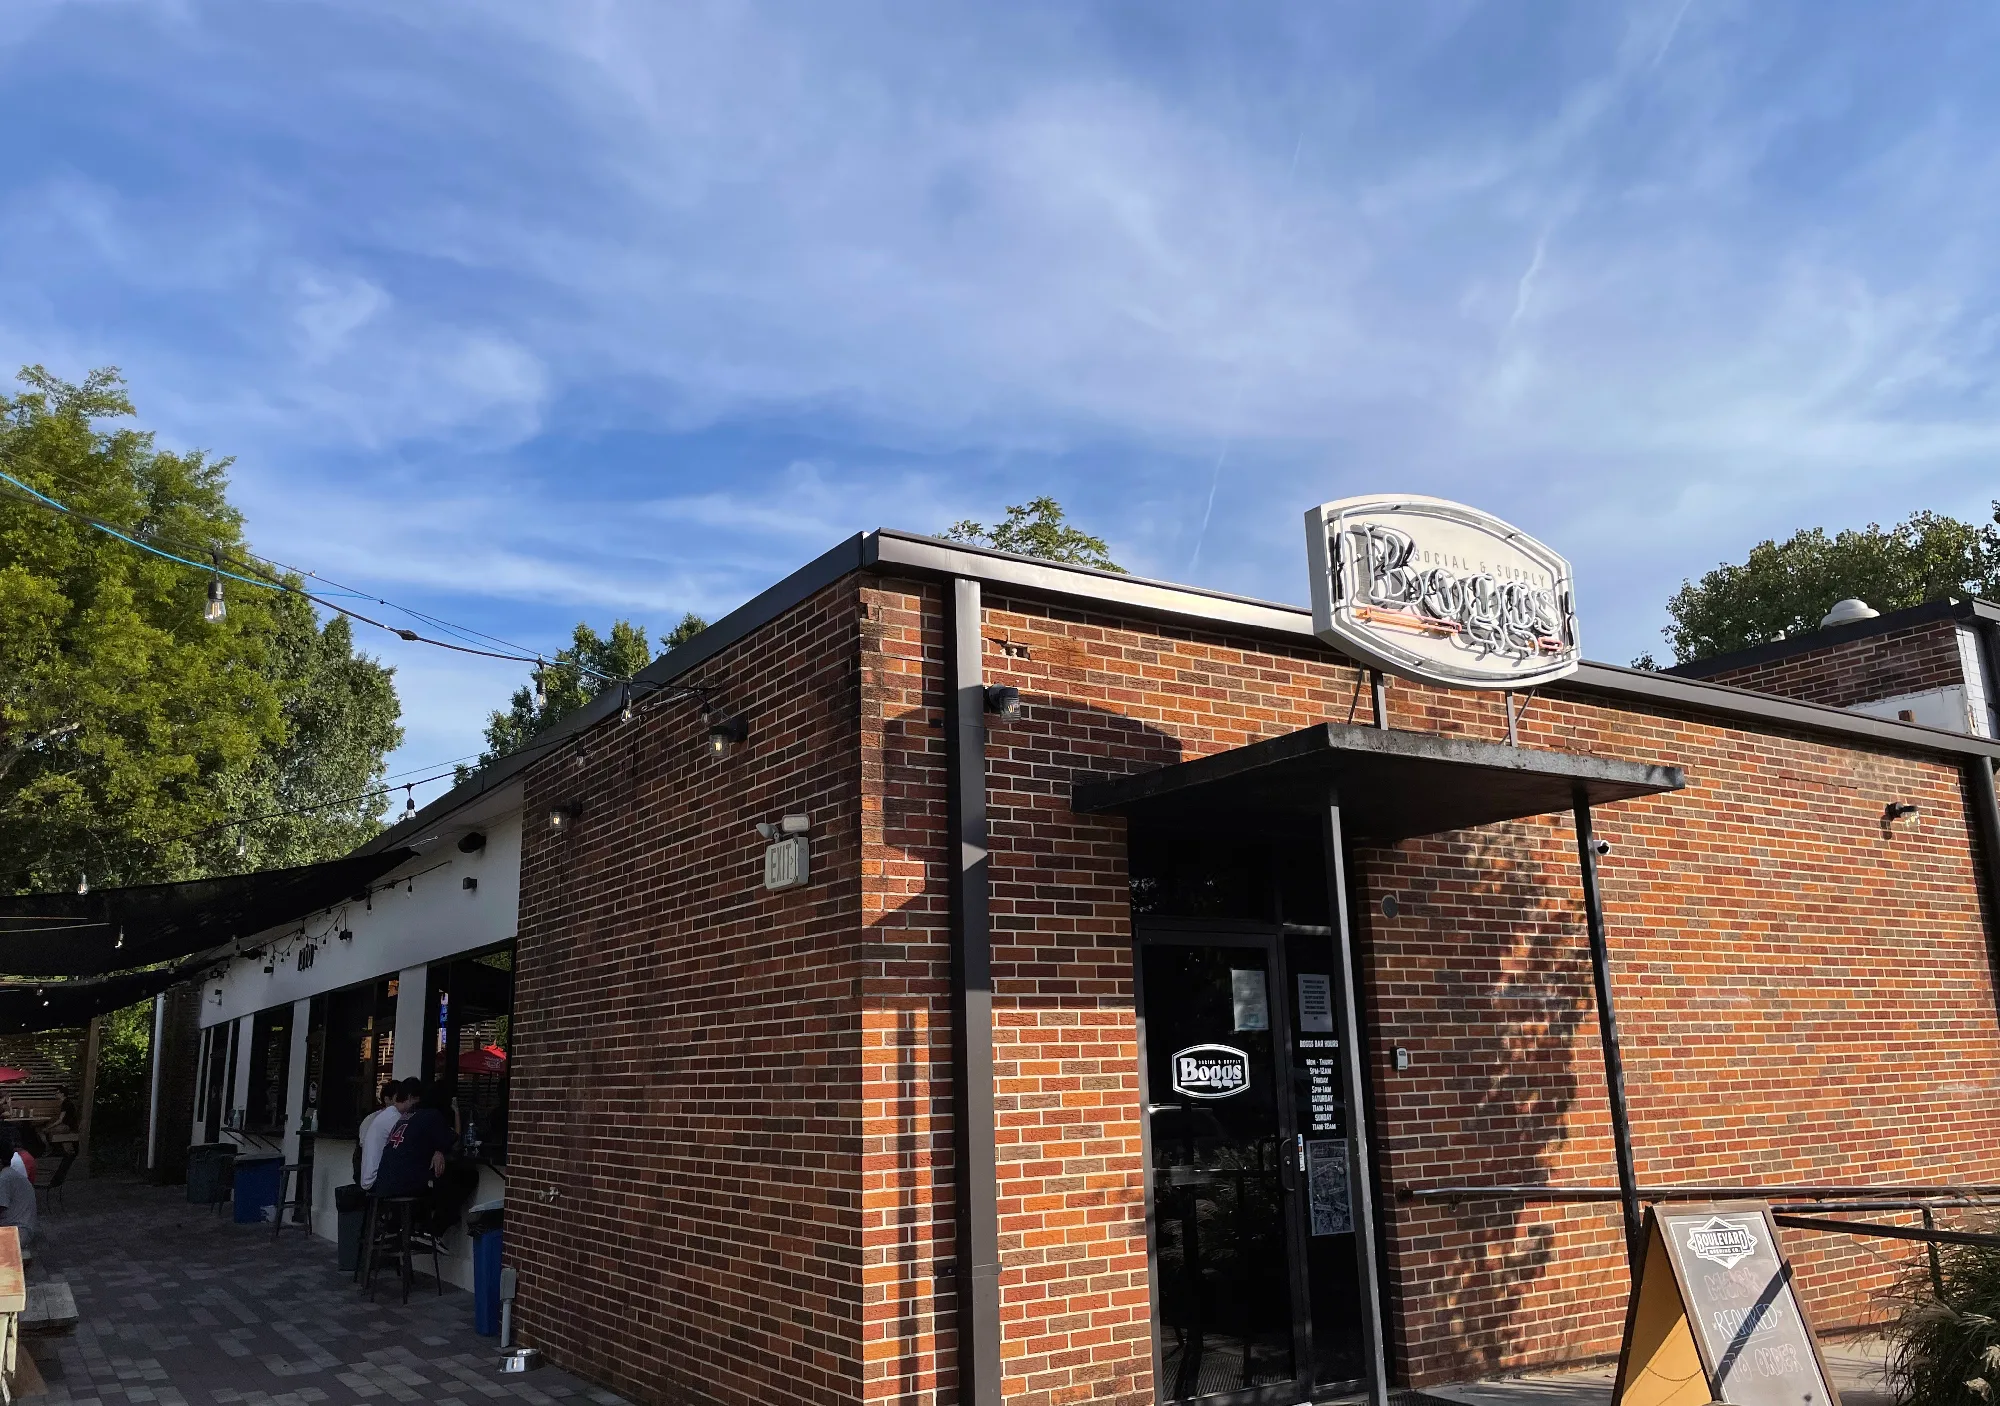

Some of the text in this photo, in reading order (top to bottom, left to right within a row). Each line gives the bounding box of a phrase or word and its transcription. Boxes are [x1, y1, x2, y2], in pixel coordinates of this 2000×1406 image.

[1414, 550, 1546, 588] SOCIAL & SUPPLY
[1352, 521, 1563, 660] Boggs
[770, 843, 792, 884] EXIT
[1180, 1057, 1243, 1089] Boggs
[1694, 1230, 1749, 1253] BOULEVARD
[1713, 1303, 1779, 1340] REQUIRED
[1754, 1343, 1804, 1378] ORDER
